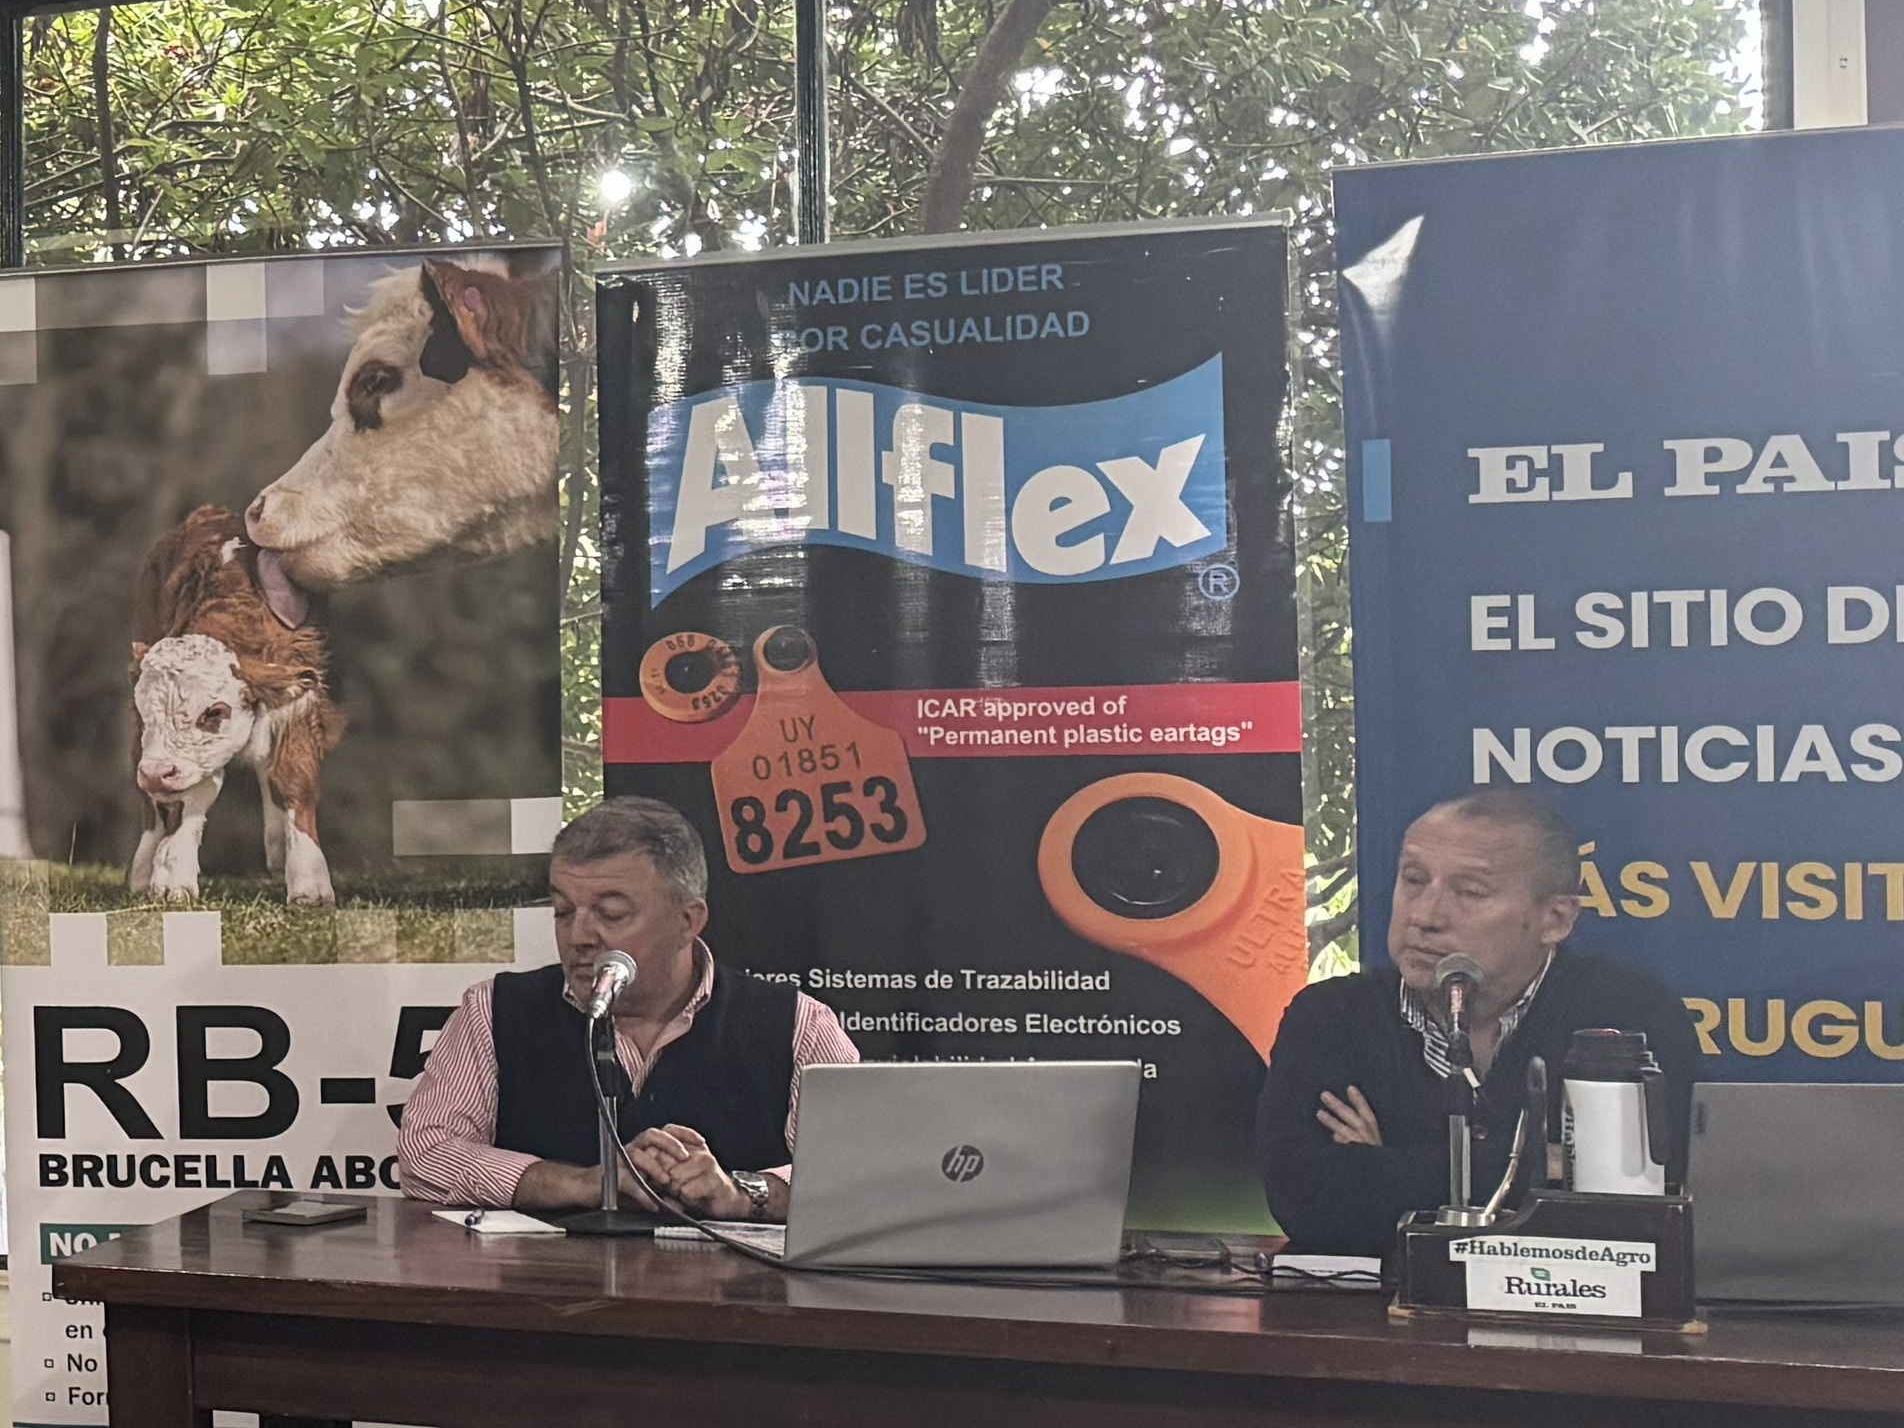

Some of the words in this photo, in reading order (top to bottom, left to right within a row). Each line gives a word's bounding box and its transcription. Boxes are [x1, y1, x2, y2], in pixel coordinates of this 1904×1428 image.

[789, 275, 893, 307] NADIE
[904, 272, 949, 300] ES
[960, 264, 1065, 296] LIDER
[860, 310, 1091, 352] CASUALIDAD
[665, 383, 1212, 576] Allflex
[1467, 443, 1634, 503] EL
[1663, 430, 1904, 497] PAI
[1470, 594, 1556, 651] EL
[1575, 587, 1804, 649] SITIO
[1827, 585, 1904, 645] D
[917, 698, 977, 718] ICAR
[984, 697, 1096, 721] approved
[1102, 696, 1128, 715] of
[779, 715, 816, 743] UY
[917, 725, 1057, 746] "Permanent
[1064, 723, 1143, 748] plastic
[1150, 721, 1254, 747] eartags"
[752, 741, 862, 780] 01851
[1472, 723, 1904, 784] NOTICIAS
[731, 775, 908, 865] 8253
[808, 969, 917, 990] Sistemas
[924, 969, 953, 990] de
[960, 969, 1111, 991] Trazabilidad
[839, 1011, 1018, 1034] Identificadores
[1025, 1012, 1182, 1036] Electrónicos
[39, 1154, 294, 1189] BRUCELLA
[943, 1146, 983, 1181] hp
[1454, 1240, 1651, 1267] #HablemosdeAgro
[1504, 1276, 1607, 1298] Rurales
[65, 1323, 93, 1339] en
[67, 1353, 98, 1373] No
